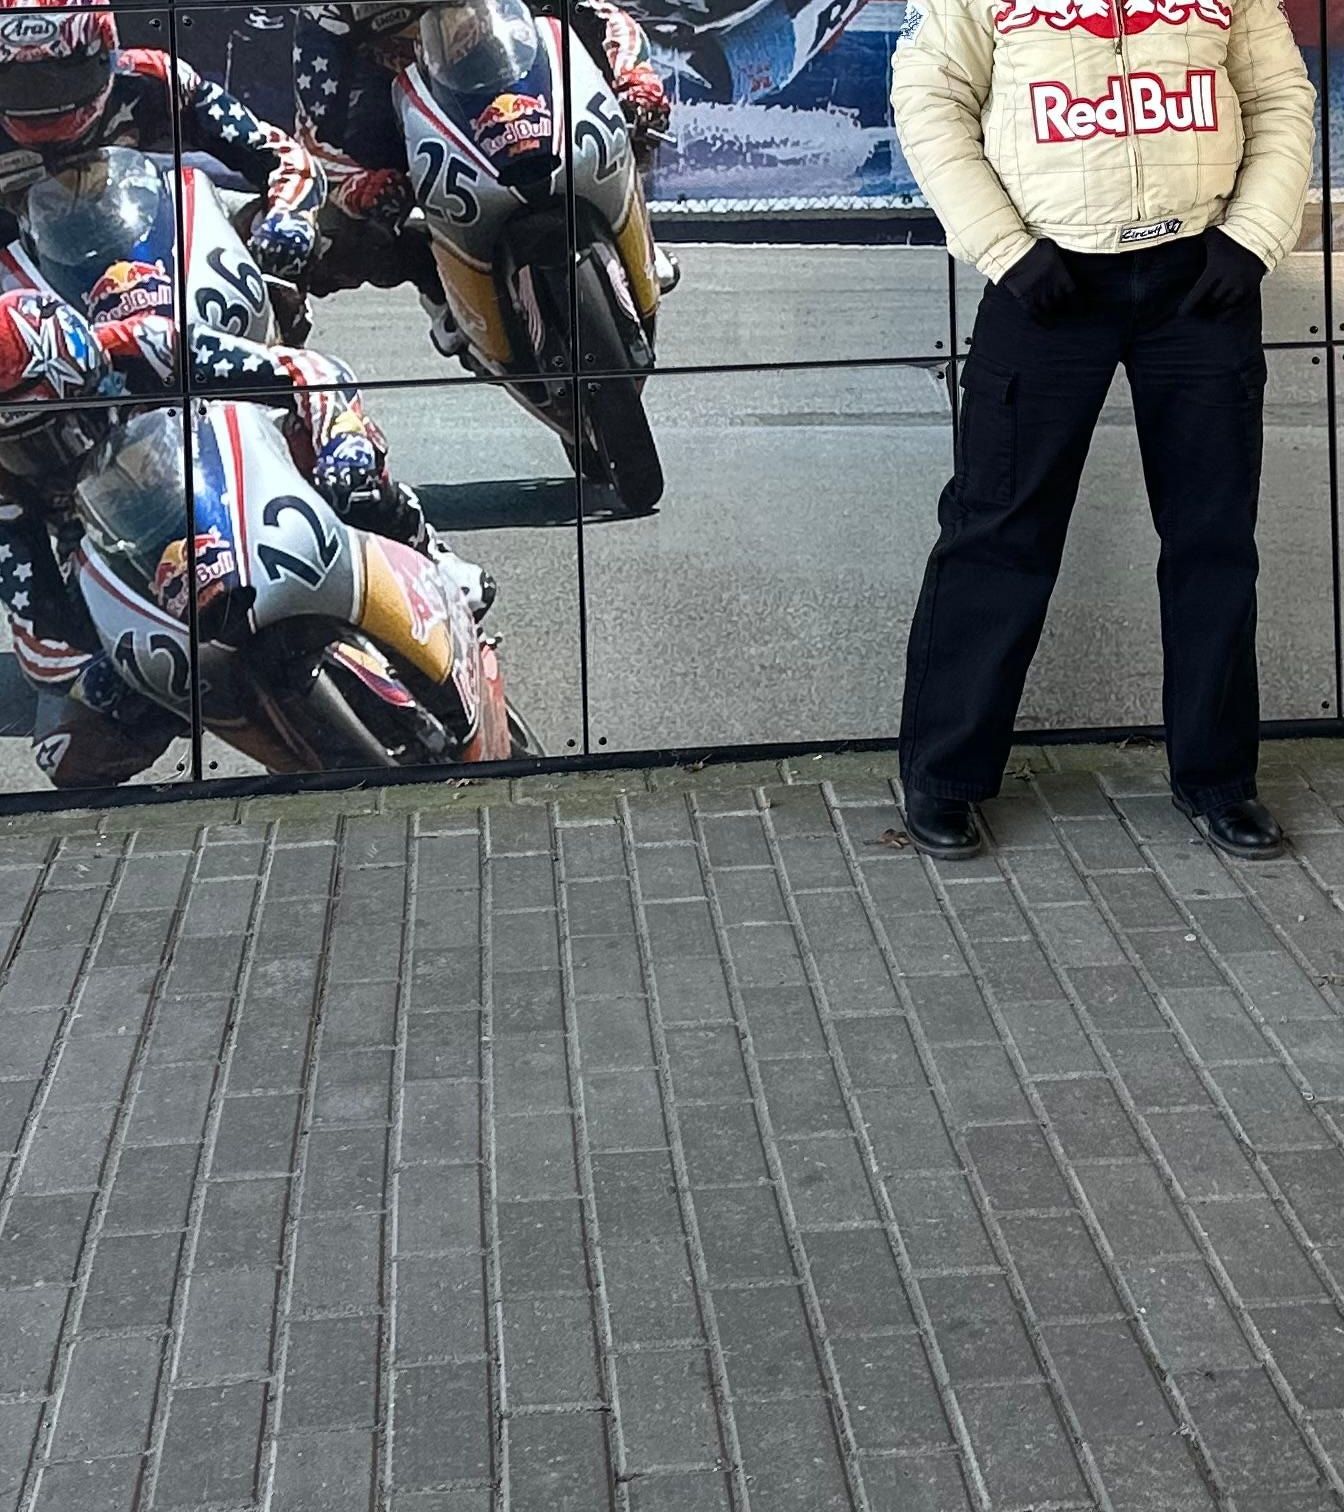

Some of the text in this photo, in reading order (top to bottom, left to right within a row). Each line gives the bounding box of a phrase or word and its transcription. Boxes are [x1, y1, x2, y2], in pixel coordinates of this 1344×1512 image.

[8, 15, 51, 39] Arai
[514, 118, 552, 142] Bull
[575, 90, 629, 184] 25
[1029, 70, 1218, 144] Red Bull
[416, 137, 480, 227] 25
[132, 285, 173, 310] Bull
[195, 245, 266, 338] 36
[257, 494, 341, 591] 12
